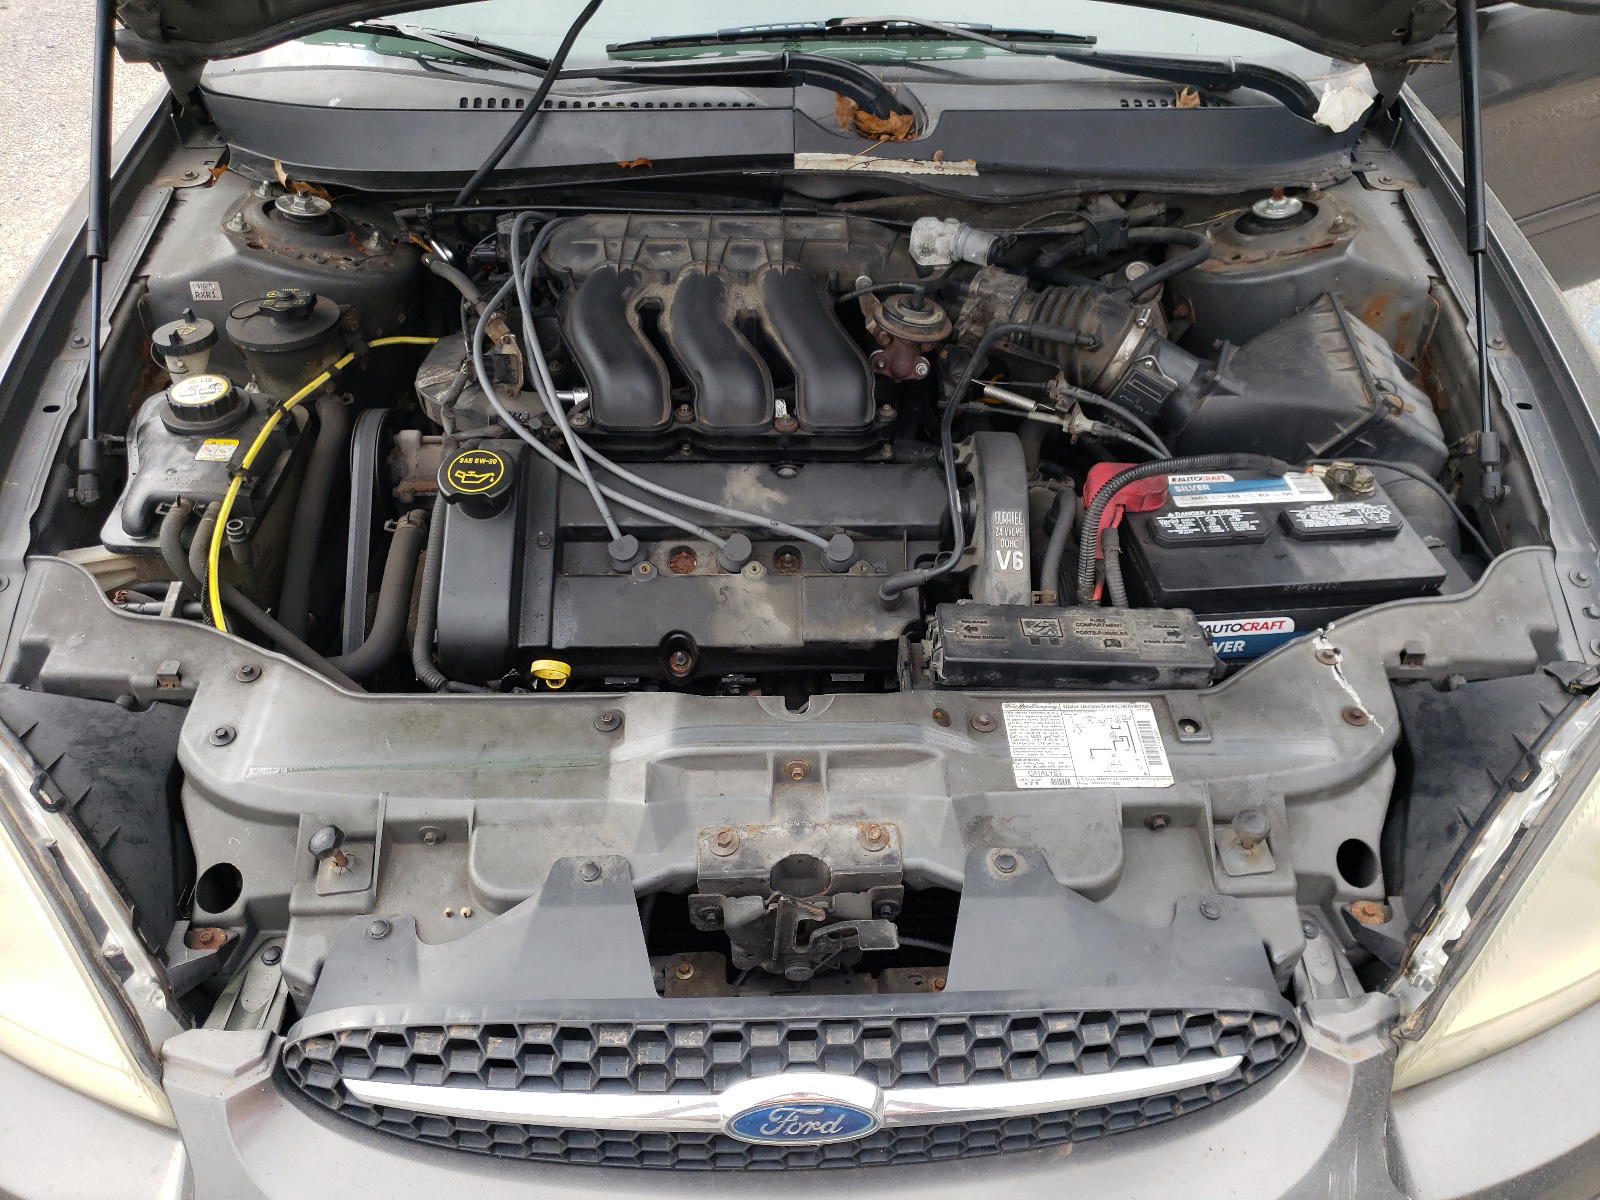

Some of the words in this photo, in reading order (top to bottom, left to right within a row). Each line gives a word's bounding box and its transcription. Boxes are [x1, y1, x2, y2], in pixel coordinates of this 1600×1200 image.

[474, 457, 498, 465] 5W-20
[1174, 484, 1211, 493] SILVER
[995, 549, 1024, 571] V6
[1204, 620, 1286, 634] AUTOCRAFT
[759, 1106, 846, 1136] Ford
